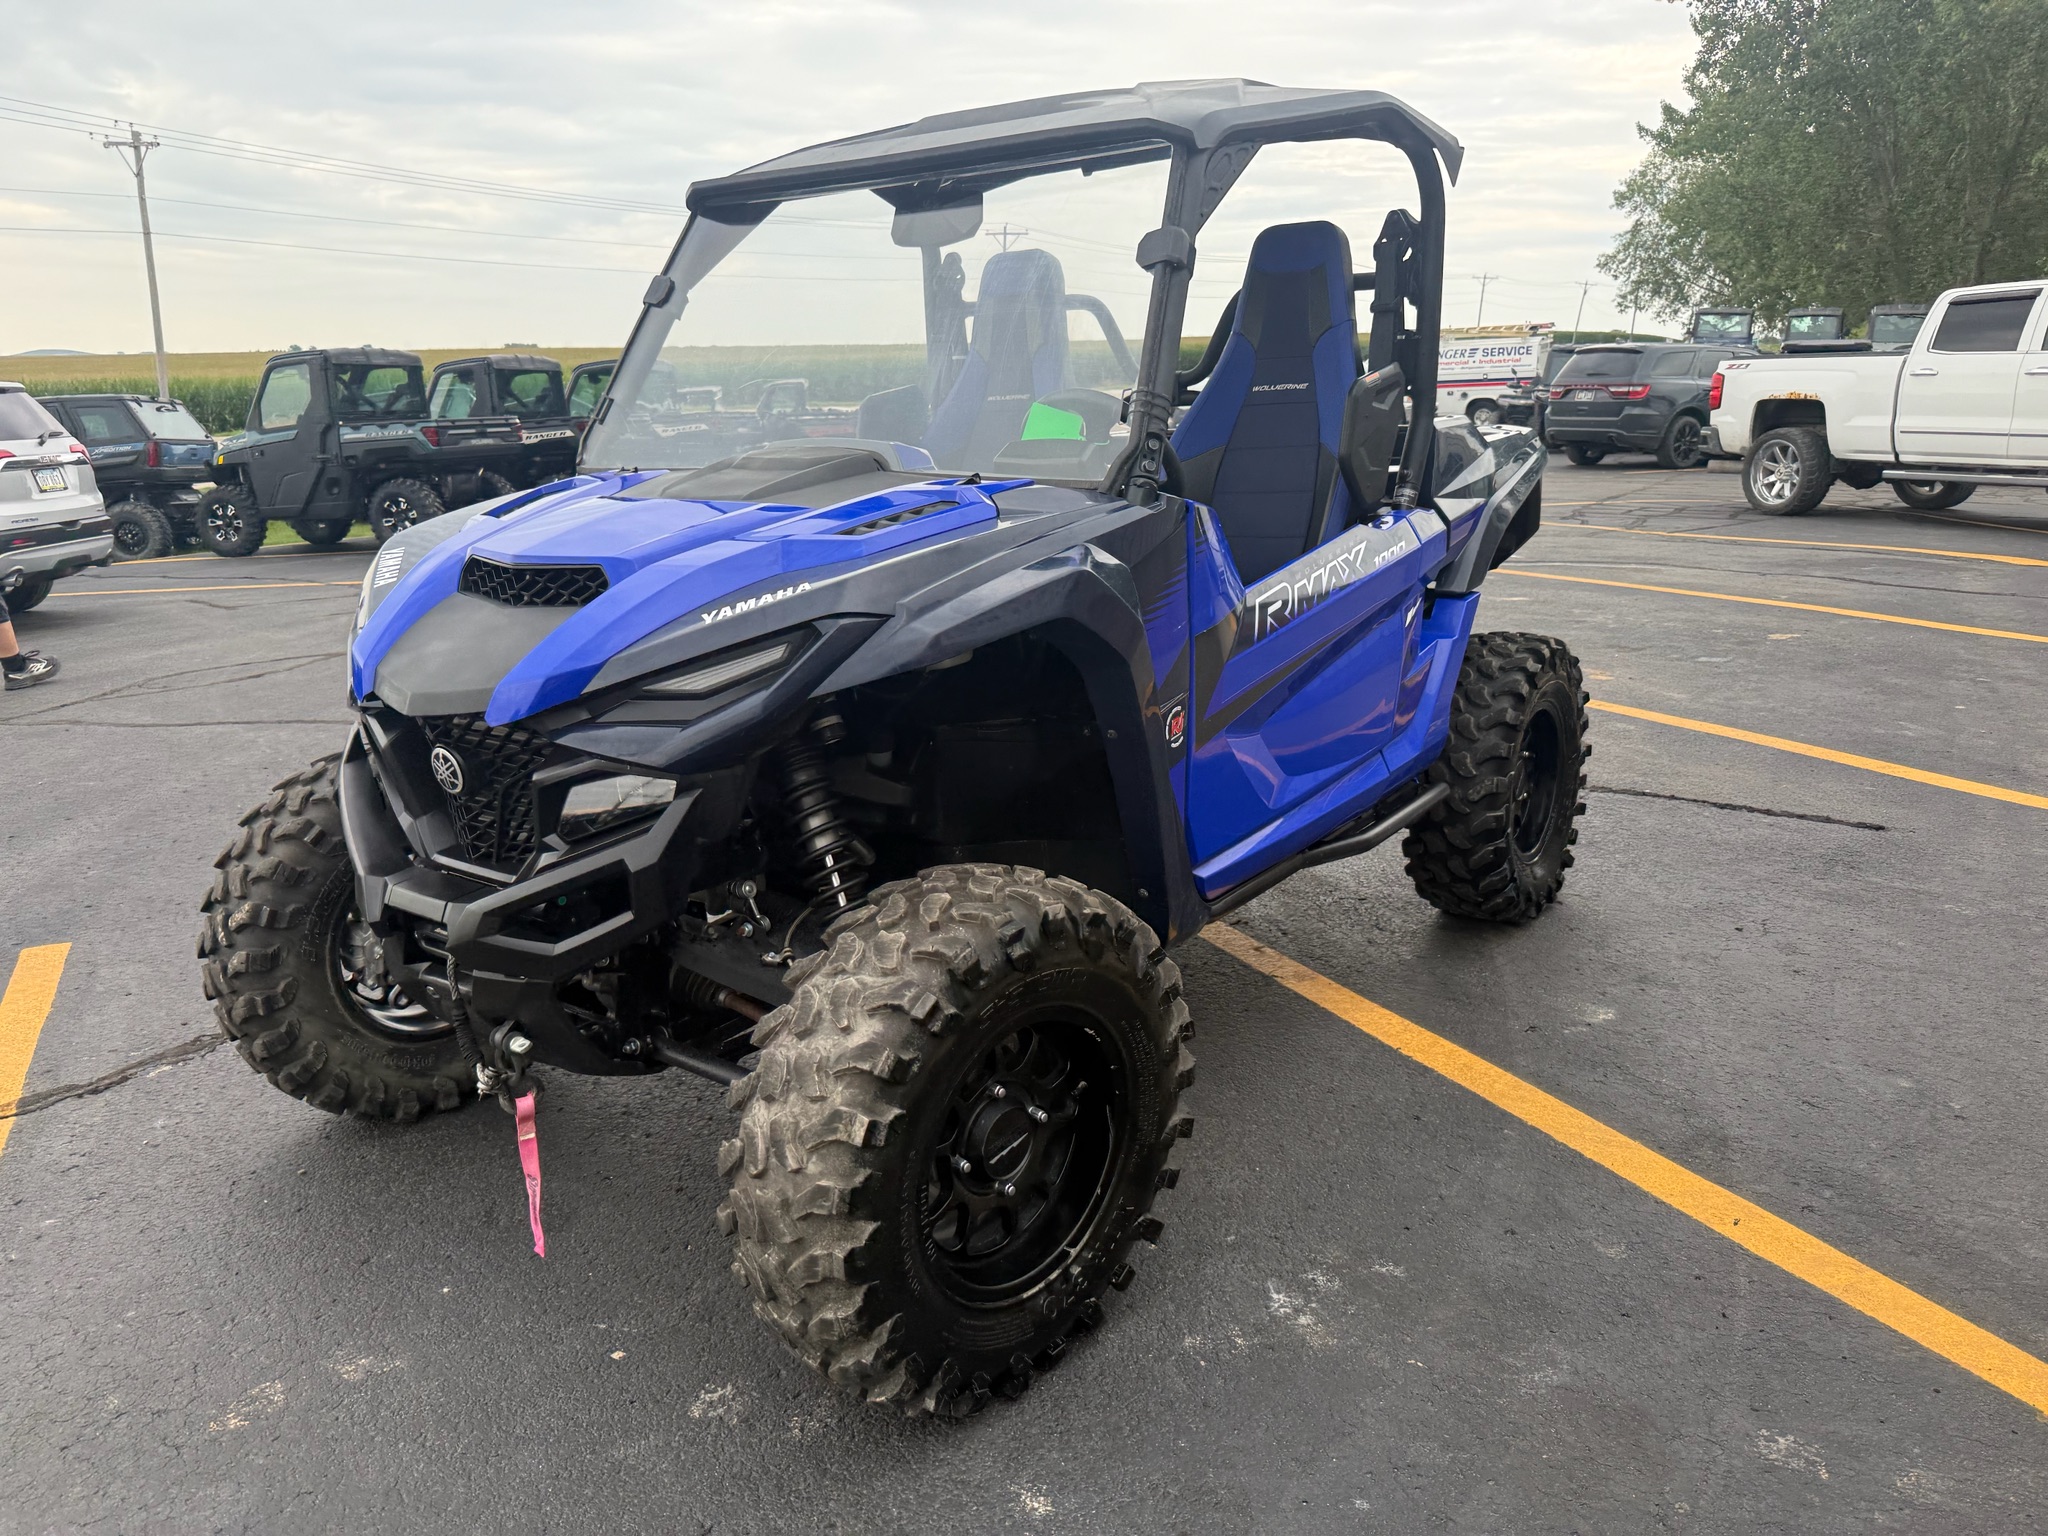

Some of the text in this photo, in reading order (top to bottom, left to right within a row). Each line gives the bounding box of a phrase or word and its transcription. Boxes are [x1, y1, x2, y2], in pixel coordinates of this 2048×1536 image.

[1482, 346, 1532, 357] SERVICE
[1478, 357, 1521, 365] Industrial
[1252, 382, 1309, 392] WOLVERINE
[365, 430, 409, 438] RANGER
[525, 431, 567, 440] RANGER
[373, 546, 405, 588] YAMAHA
[1254, 540, 1406, 645] RMAX 1000
[701, 582, 812, 625] YAMAHA
